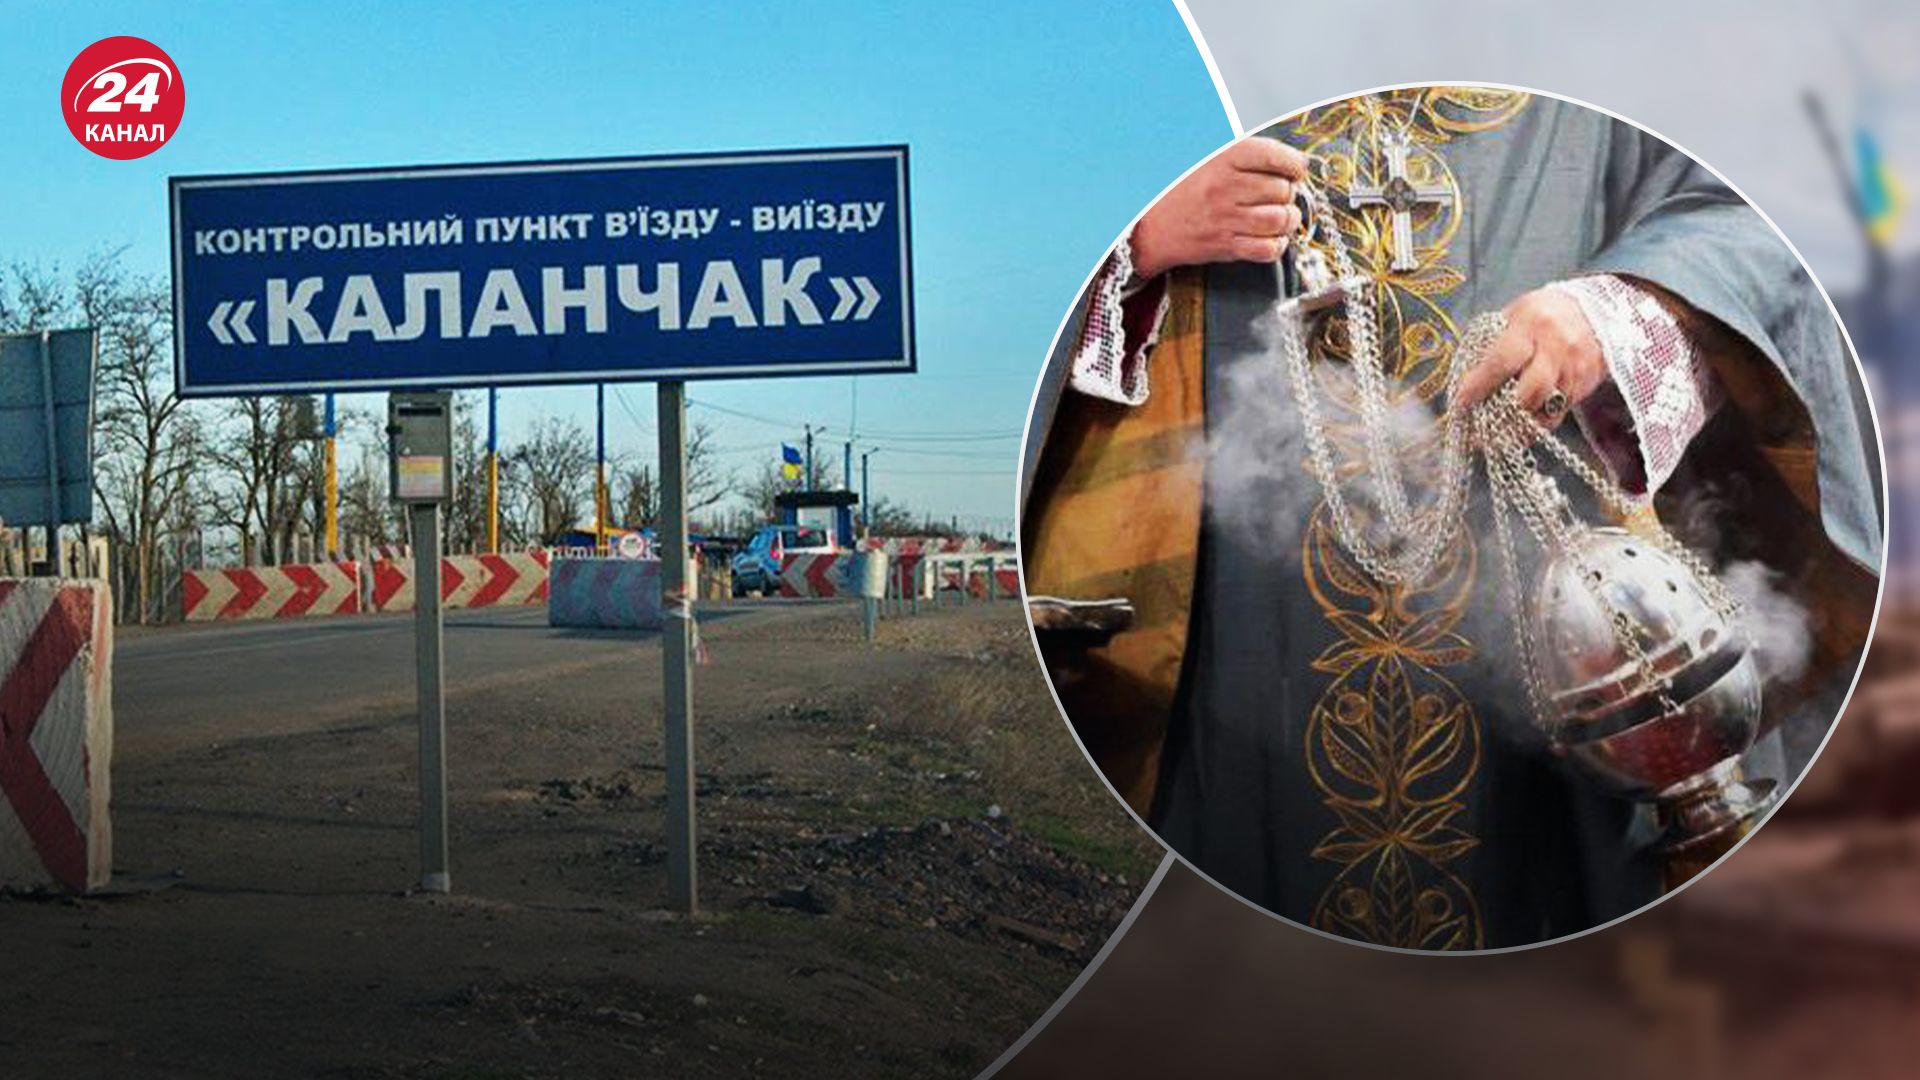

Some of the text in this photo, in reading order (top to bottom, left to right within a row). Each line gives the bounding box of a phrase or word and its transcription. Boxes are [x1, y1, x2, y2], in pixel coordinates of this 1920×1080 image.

[194, 213, 464, 255] КОНТРОЛЬНИЙ
[475, 213, 593, 243] ПУНКТ
[752, 199, 886, 233] ВИЇЗДУ
[207, 256, 882, 346] «КАЛАНЧАК»
